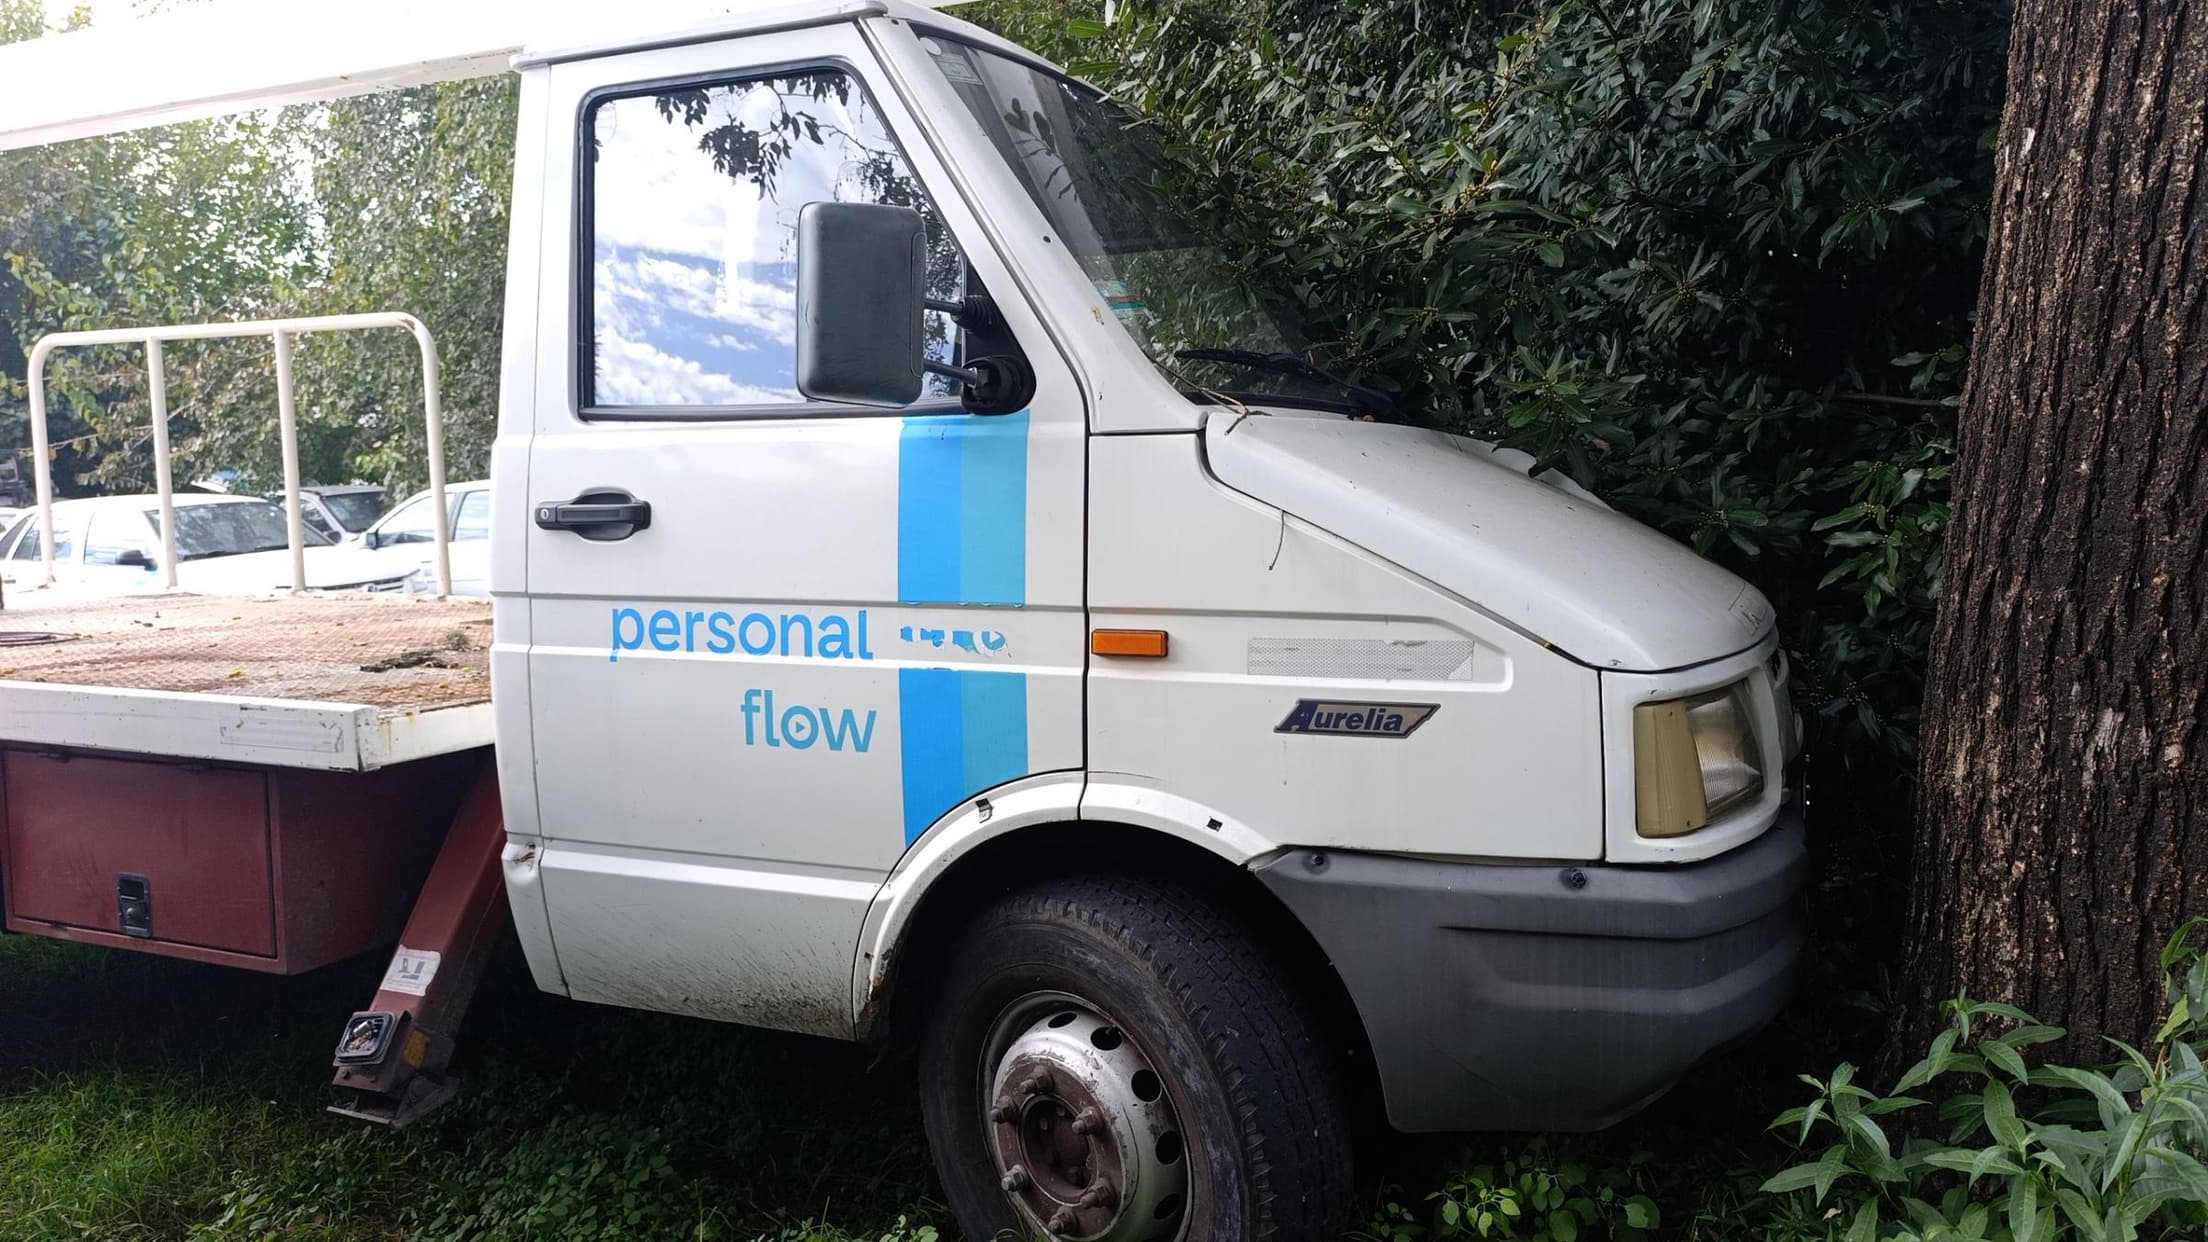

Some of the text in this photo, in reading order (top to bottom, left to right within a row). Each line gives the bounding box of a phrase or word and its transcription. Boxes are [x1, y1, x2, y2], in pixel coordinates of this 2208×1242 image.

[610, 607, 874, 662] personal
[740, 688, 877, 753] flow
[1281, 701, 1403, 732] Aurelia
